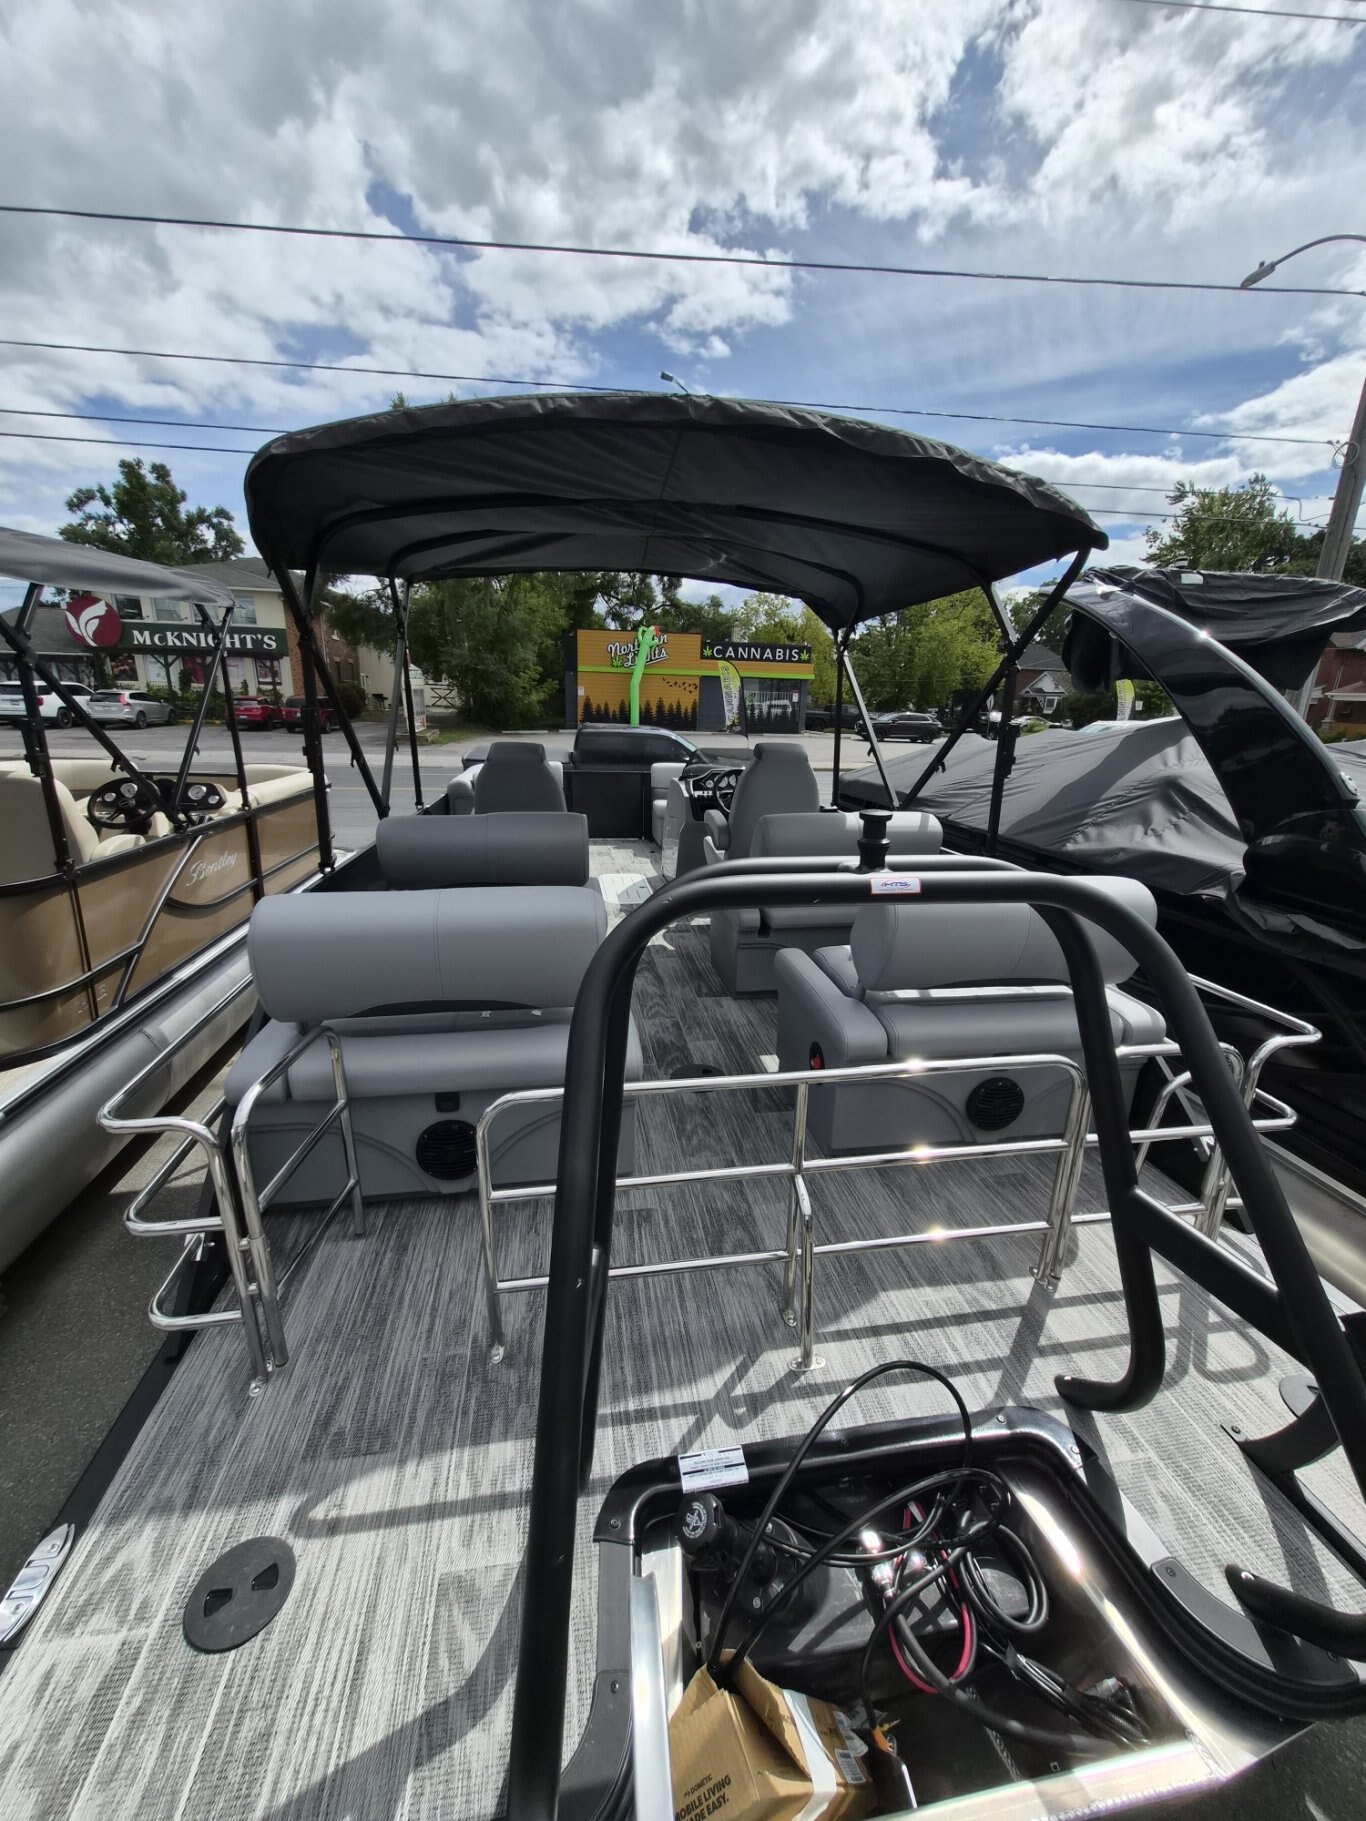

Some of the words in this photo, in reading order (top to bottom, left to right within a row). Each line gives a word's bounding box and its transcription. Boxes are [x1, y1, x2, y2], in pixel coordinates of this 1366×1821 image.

[713, 646, 799, 661] CANNABIS
[185, 850, 238, 887] Bentley
[703, 1774, 731, 1803] LIVING
[706, 1791, 730, 1816] EASY.
